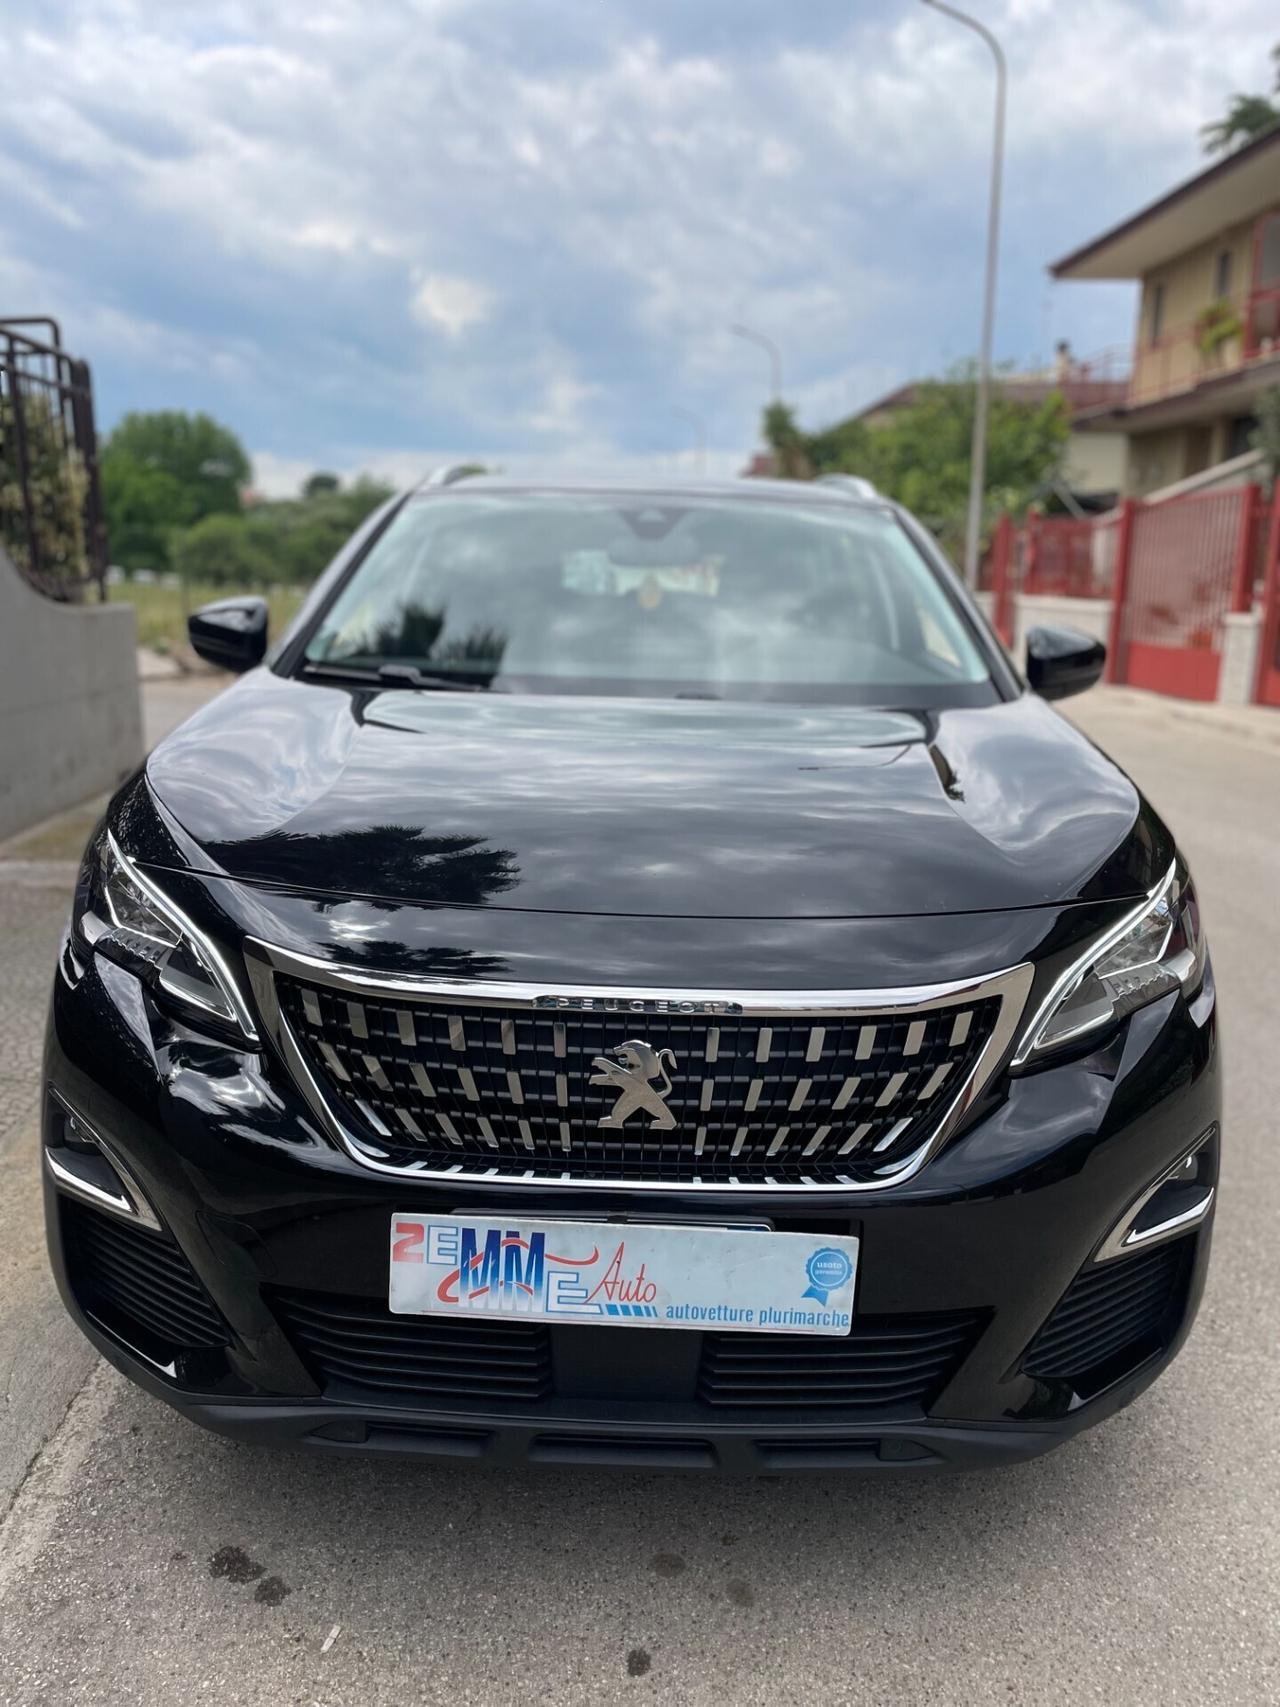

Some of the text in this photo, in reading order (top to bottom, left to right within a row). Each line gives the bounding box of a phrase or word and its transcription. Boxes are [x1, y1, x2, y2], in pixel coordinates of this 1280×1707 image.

[556, 997, 720, 1013] PEUGEOT
[584, 1241, 657, 1304] Auto
[666, 1303, 850, 1328] autovetture plurimarche
